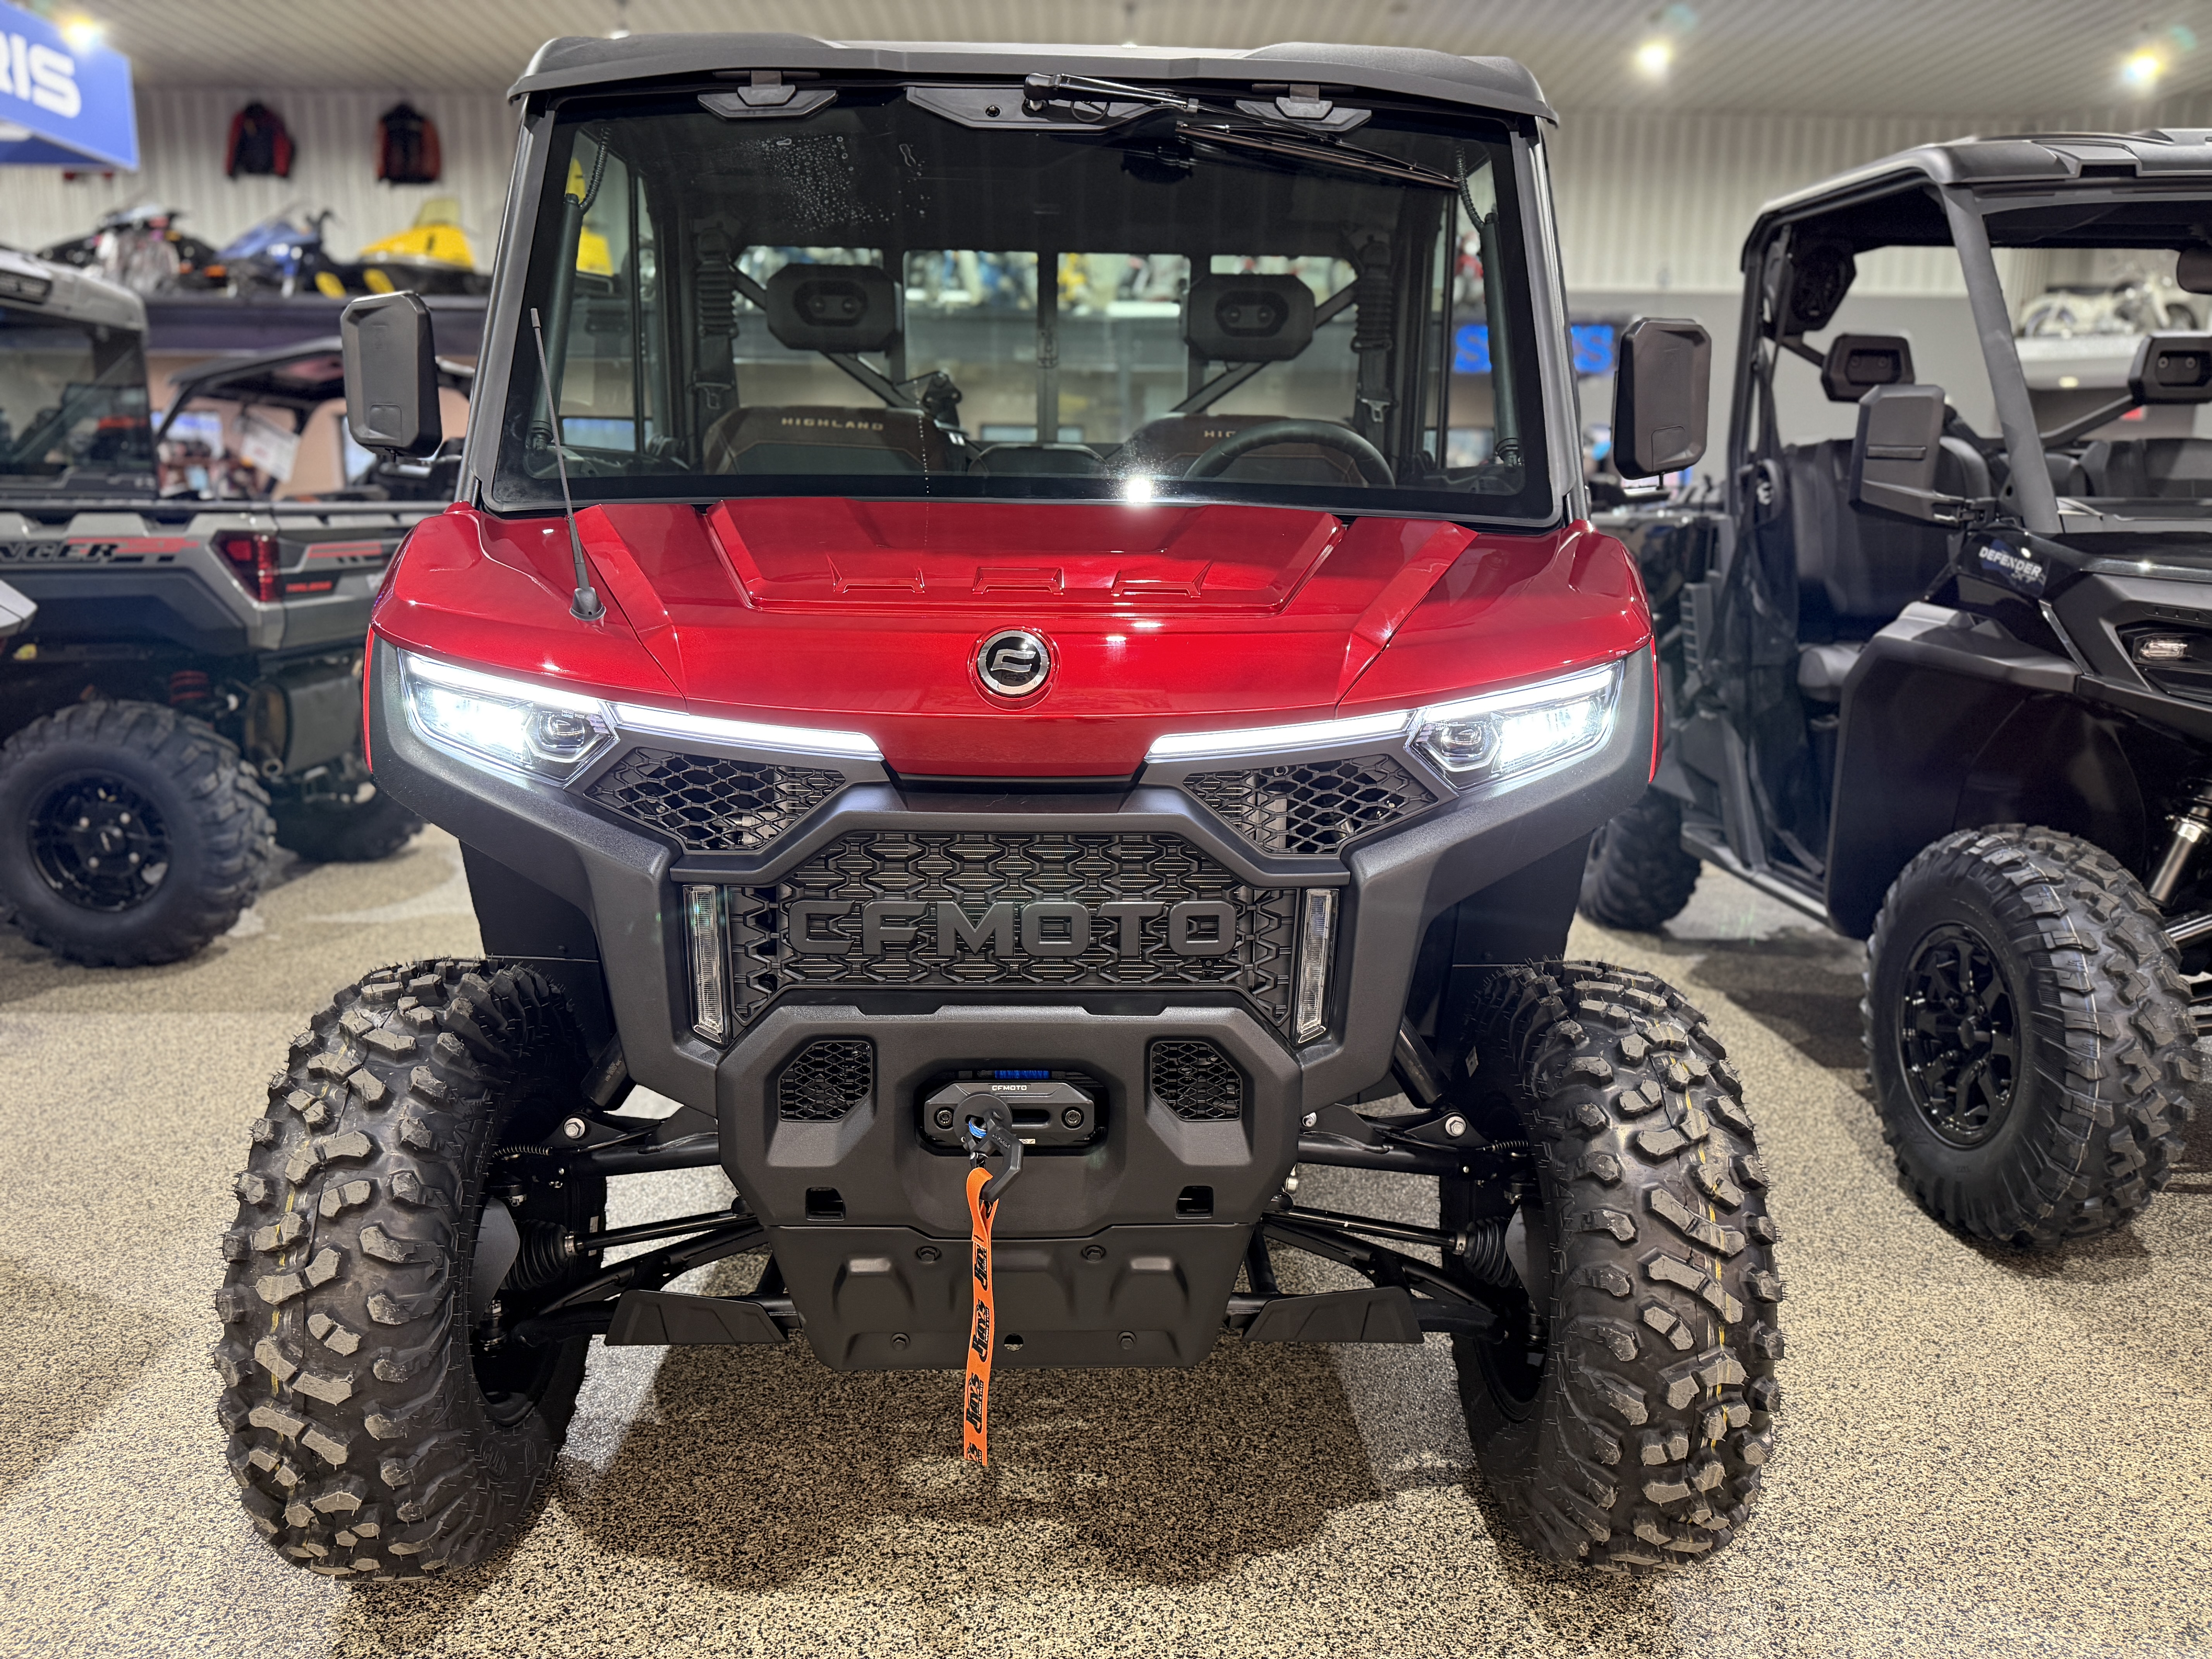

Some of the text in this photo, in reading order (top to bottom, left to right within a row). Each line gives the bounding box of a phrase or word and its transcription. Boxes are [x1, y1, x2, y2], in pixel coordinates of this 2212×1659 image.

[781, 417, 884, 431] HIGHLAND
[1978, 546, 2042, 578] DEFENDER
[788, 900, 1238, 957] CFMOTO
